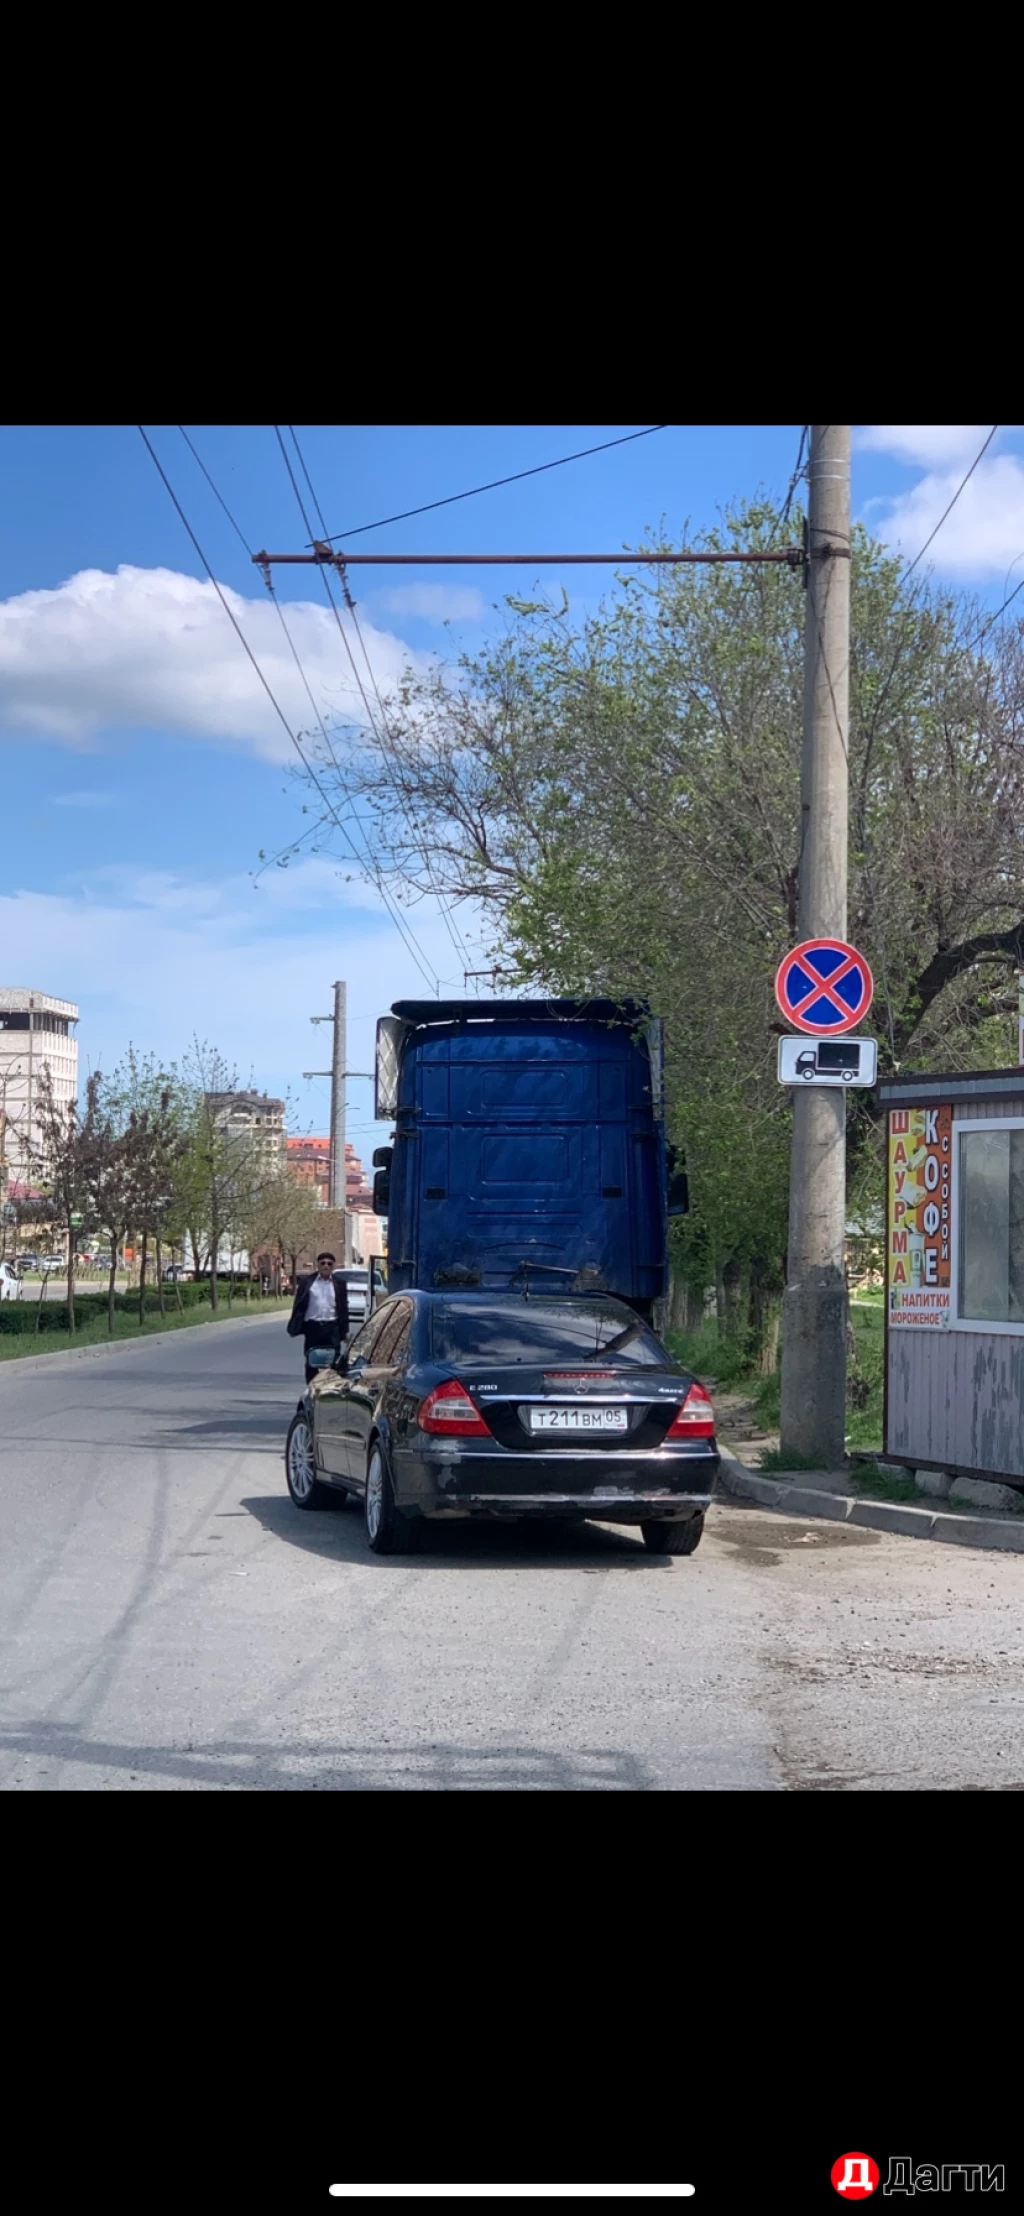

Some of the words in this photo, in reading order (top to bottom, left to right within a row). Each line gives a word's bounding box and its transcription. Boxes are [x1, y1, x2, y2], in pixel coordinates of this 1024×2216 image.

[941, 1135, 949, 1152] С
[891, 1112, 909, 1283] ШАУРМА
[923, 1108, 940, 1284] КОФЕ
[941, 1163, 949, 1260] СОБОЙ
[902, 1293, 950, 1308] НАПИТКИ
[891, 1312, 940, 1324] МОРОЖЕНОЕ
[605, 1410, 622, 1422] 05
